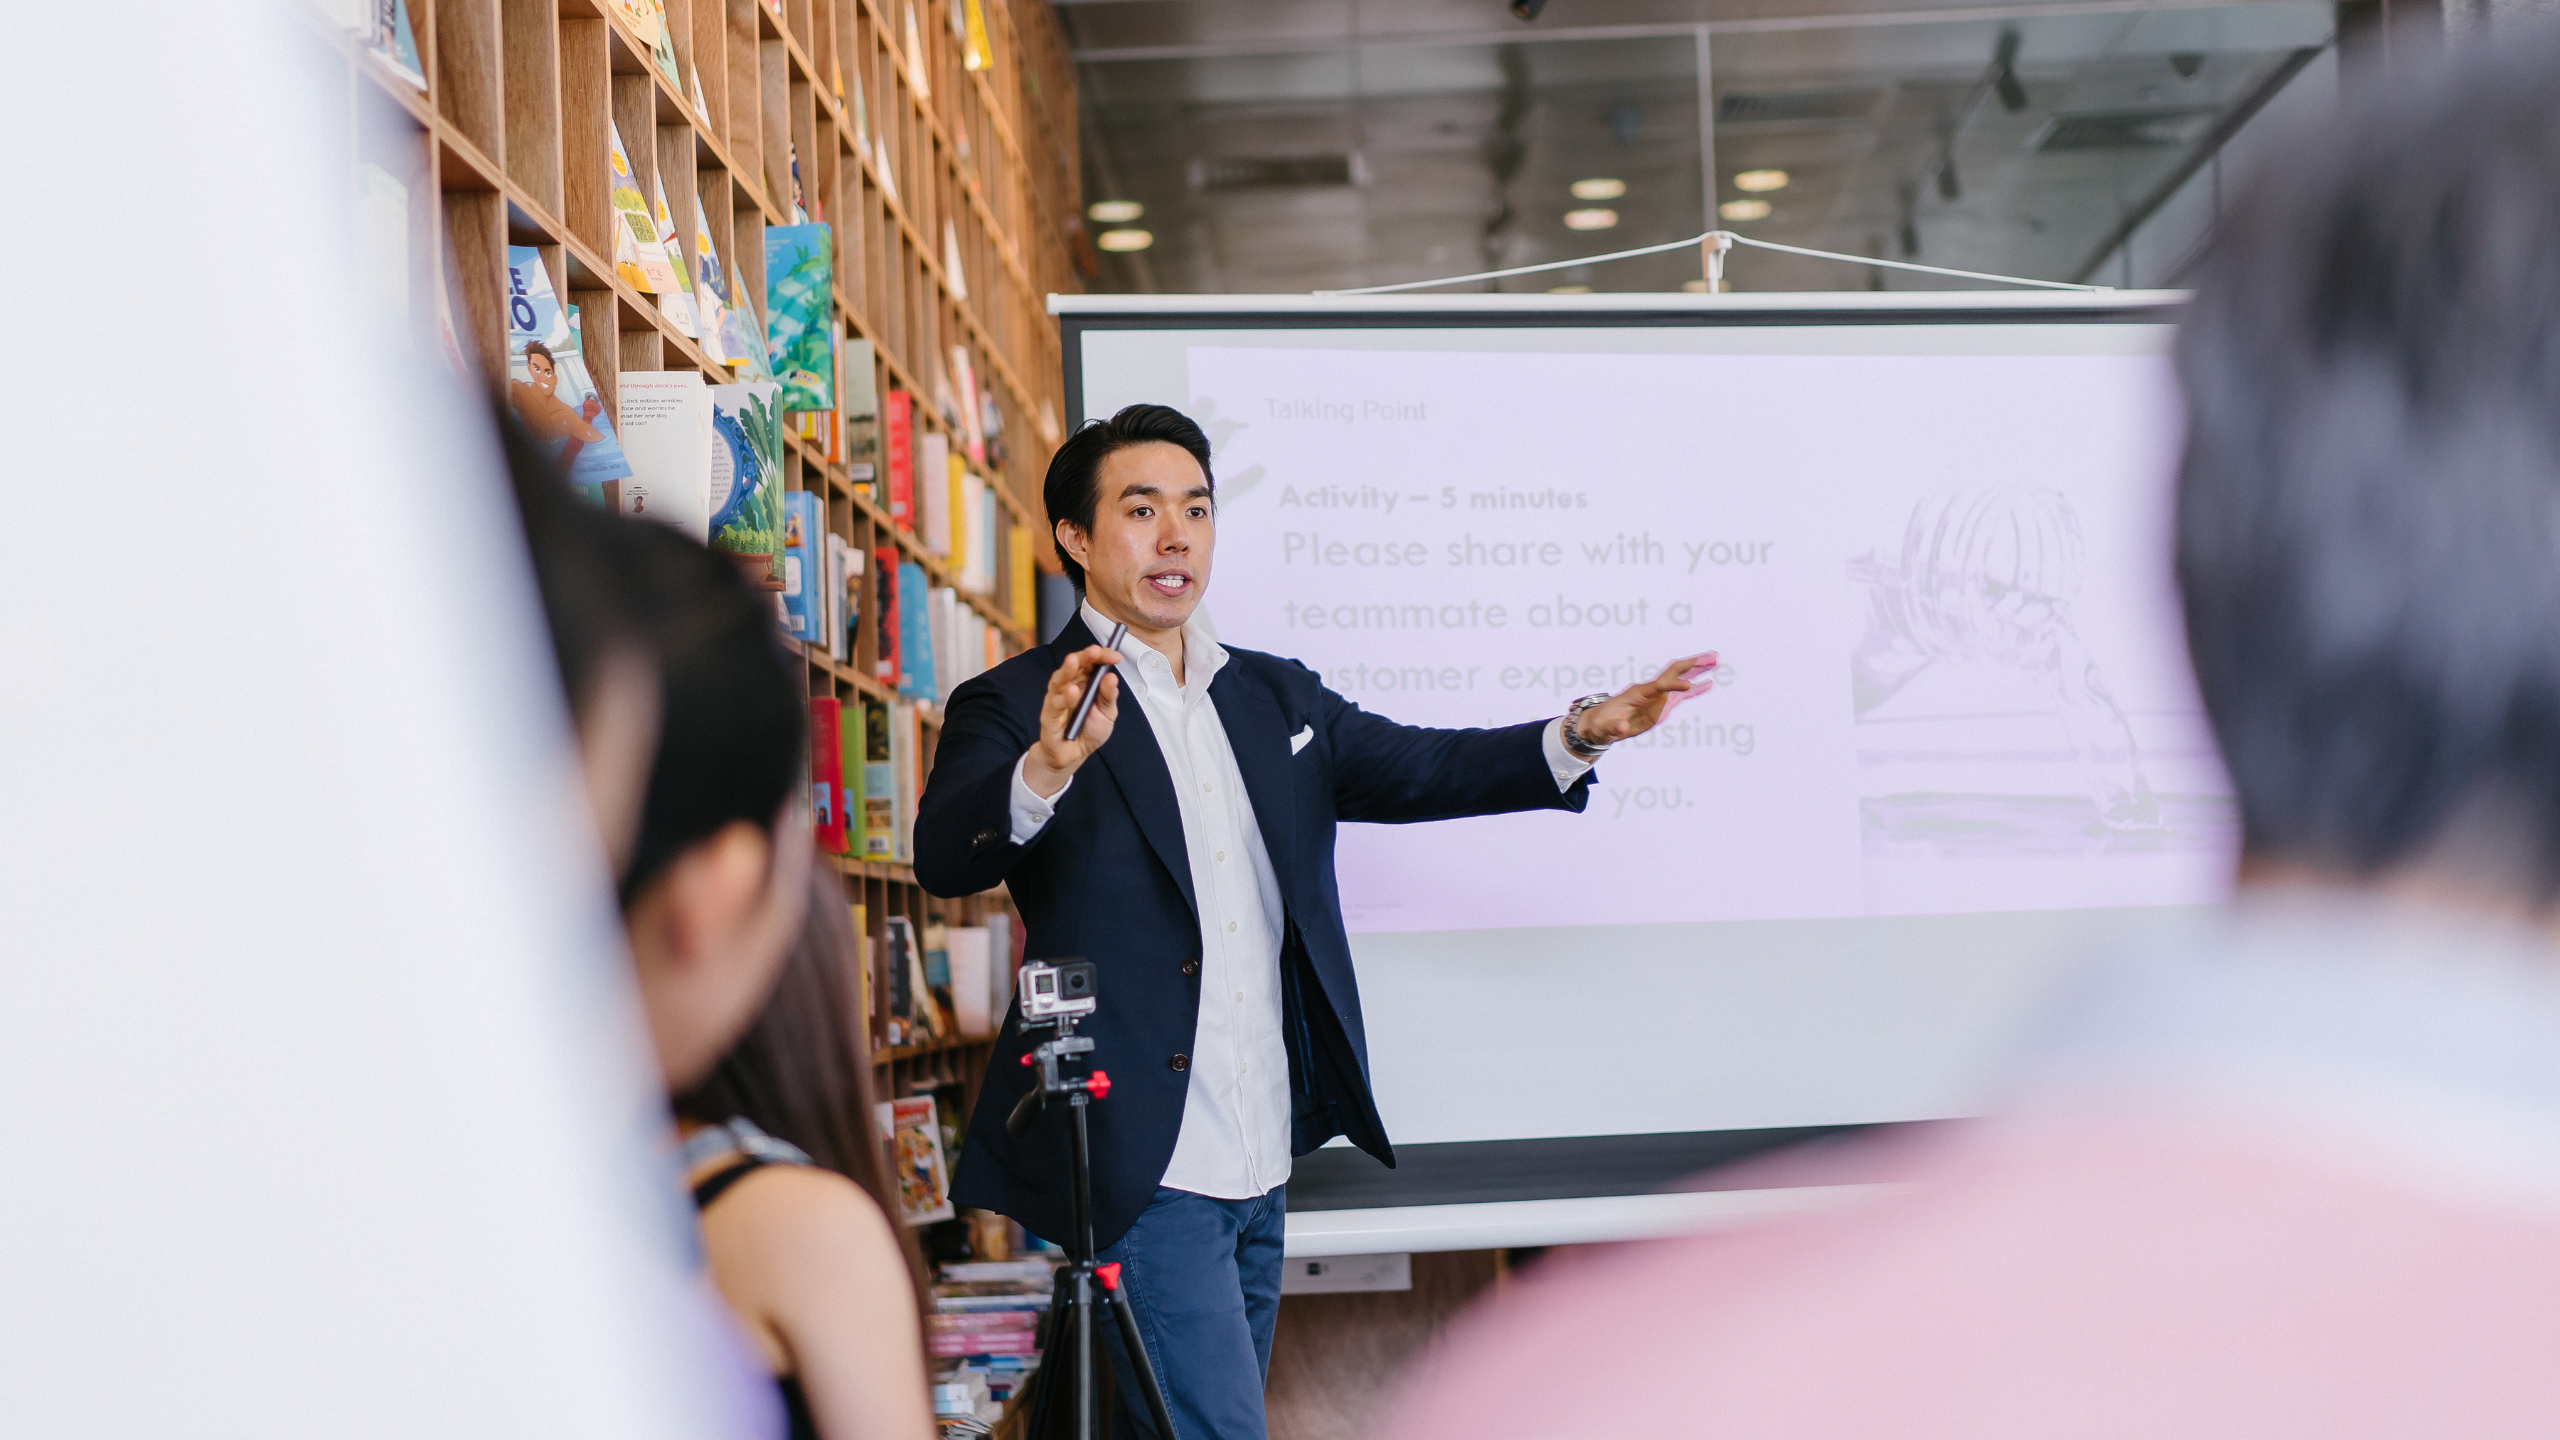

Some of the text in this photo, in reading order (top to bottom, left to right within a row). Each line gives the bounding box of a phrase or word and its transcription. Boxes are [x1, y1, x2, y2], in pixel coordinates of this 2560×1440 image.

[1264, 398, 1428, 425] Talking Point
[1279, 483, 1399, 515] Activity
[1440, 485, 1458, 509] 5
[1469, 485, 1588, 510] minutes
[1283, 530, 1774, 574] Please share with your
[1284, 592, 1694, 629] teammate about a
[1324, 655, 1736, 697] stomer experiee
[1620, 715, 1755, 756] asting
[1609, 785, 1695, 819] you.
